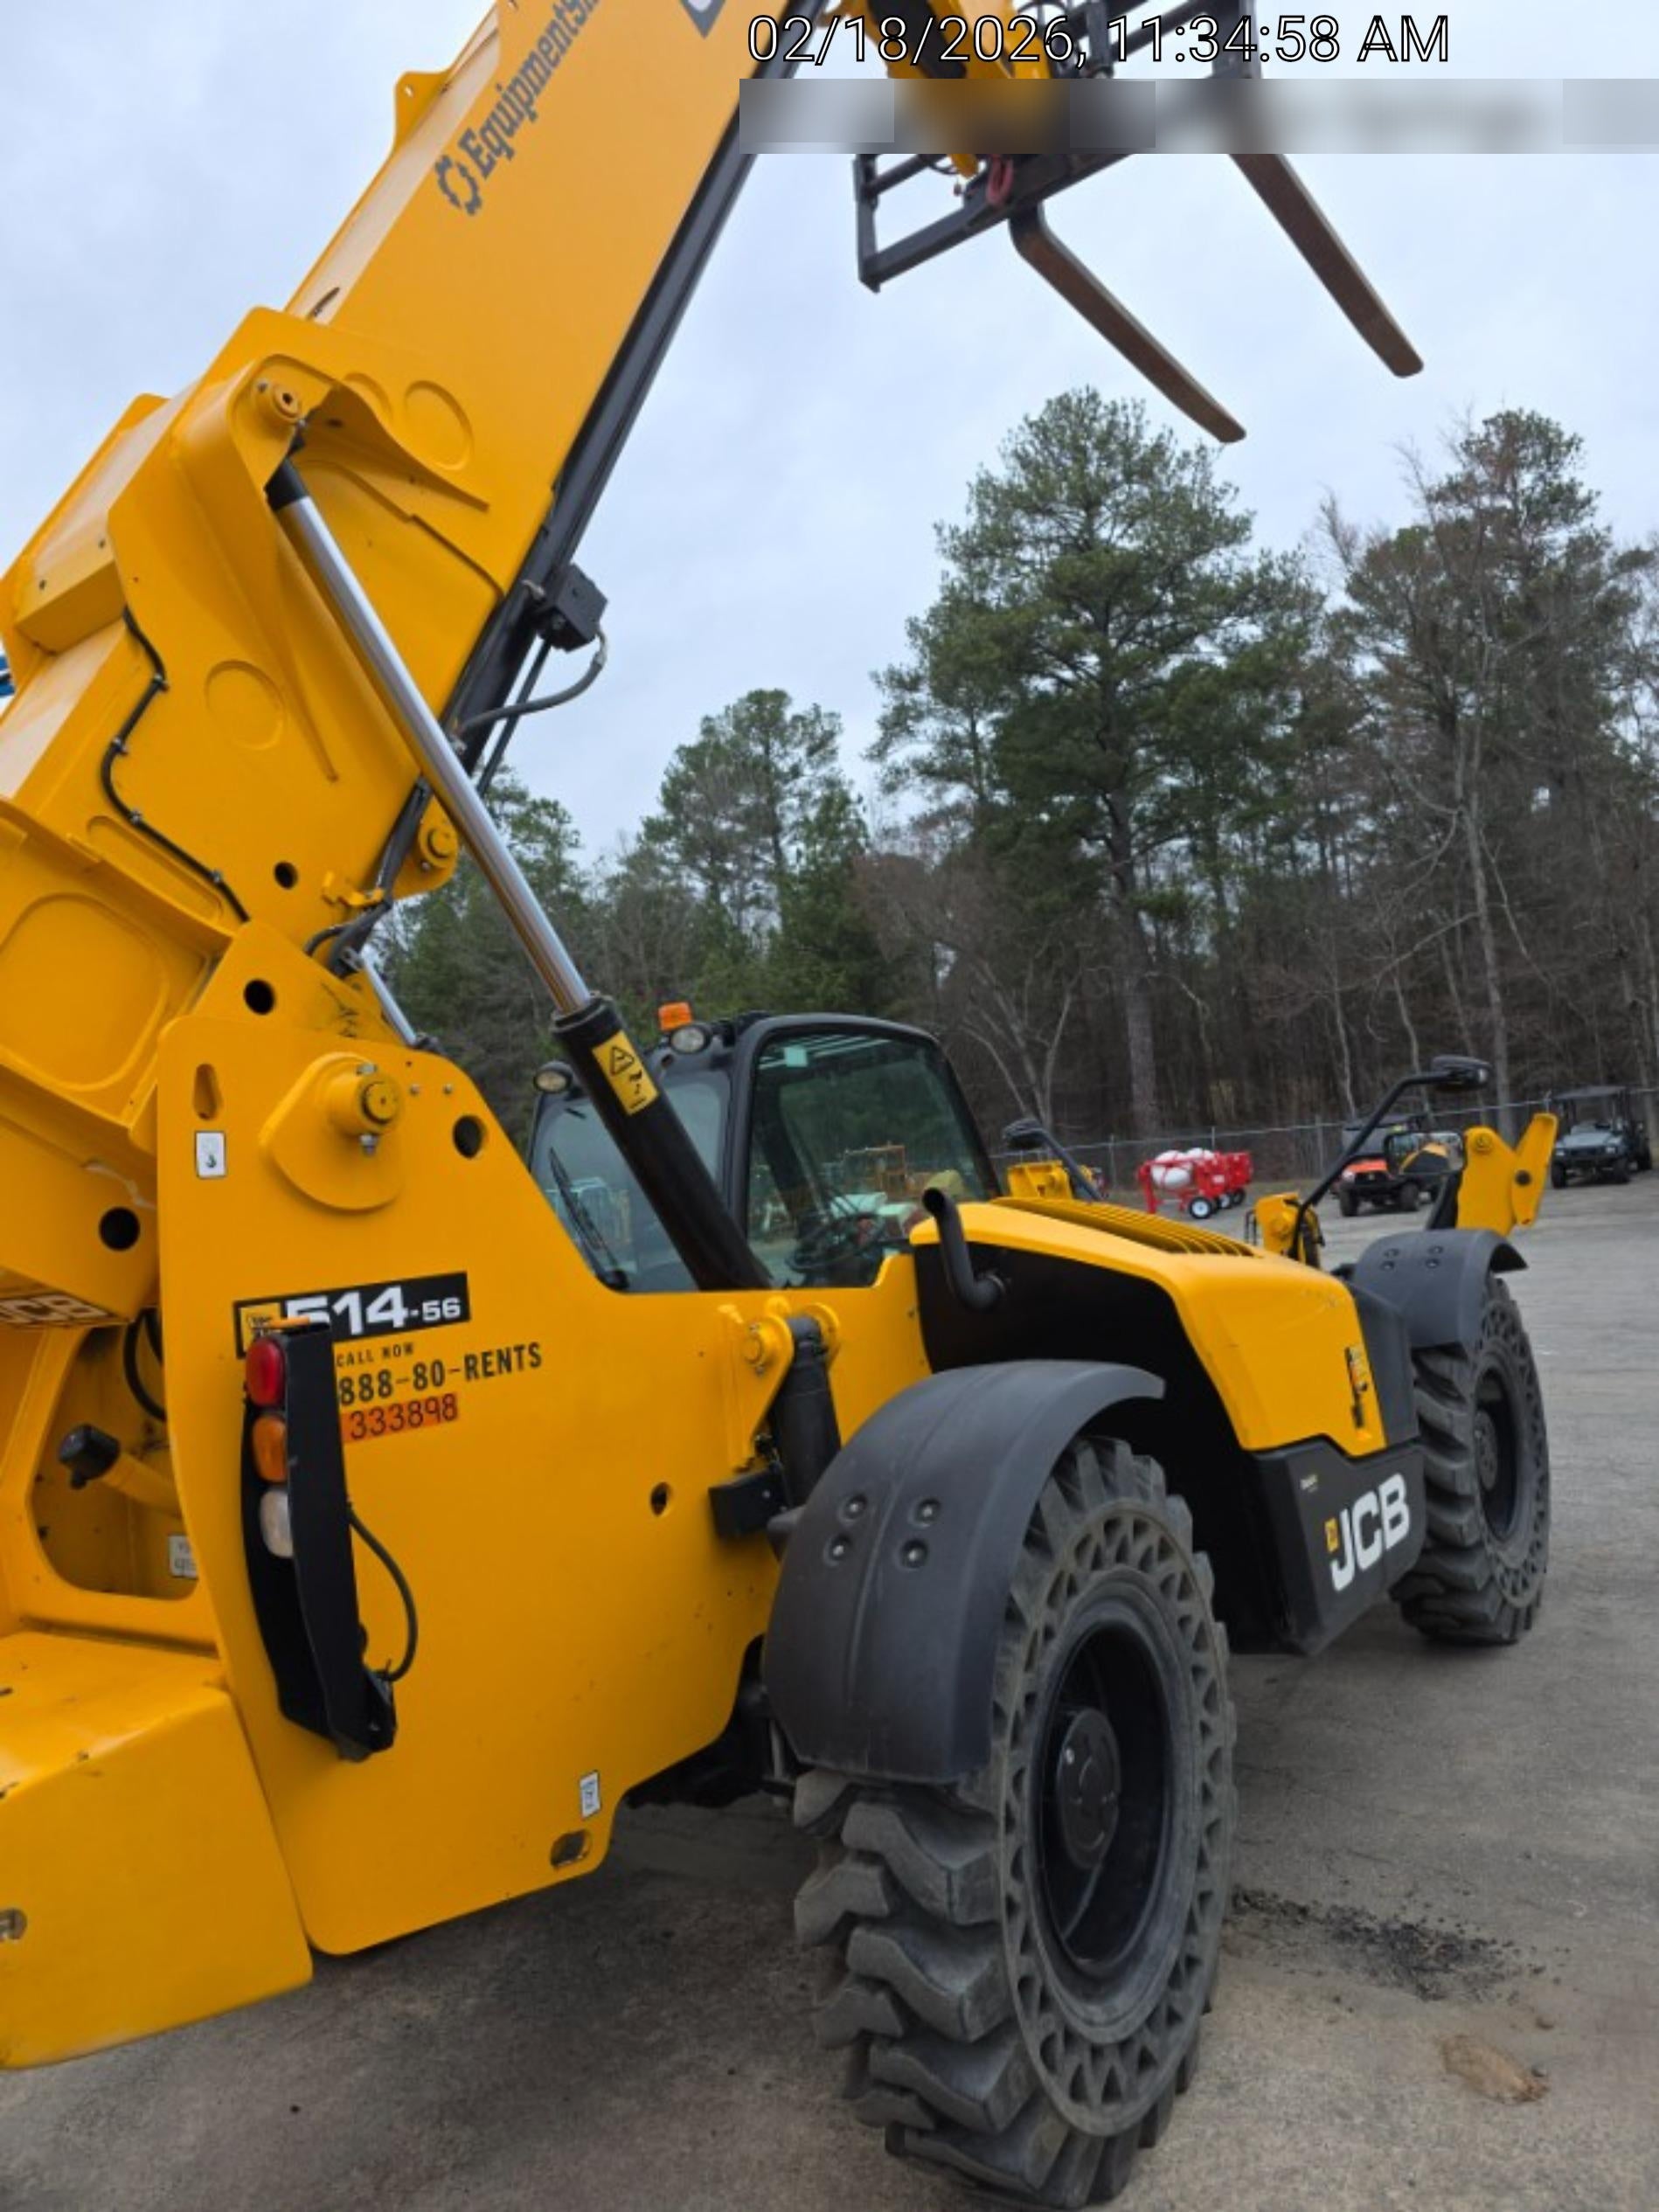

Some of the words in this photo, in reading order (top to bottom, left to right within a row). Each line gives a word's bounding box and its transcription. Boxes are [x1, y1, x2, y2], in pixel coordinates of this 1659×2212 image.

[336, 1349, 374, 1368] CALL
[382, 1342, 414, 1359] NOW
[338, 1342, 542, 1406] 888-80-RENTS
[350, 1392, 458, 1440] 333898
[1329, 1472, 1410, 1592] JCB
